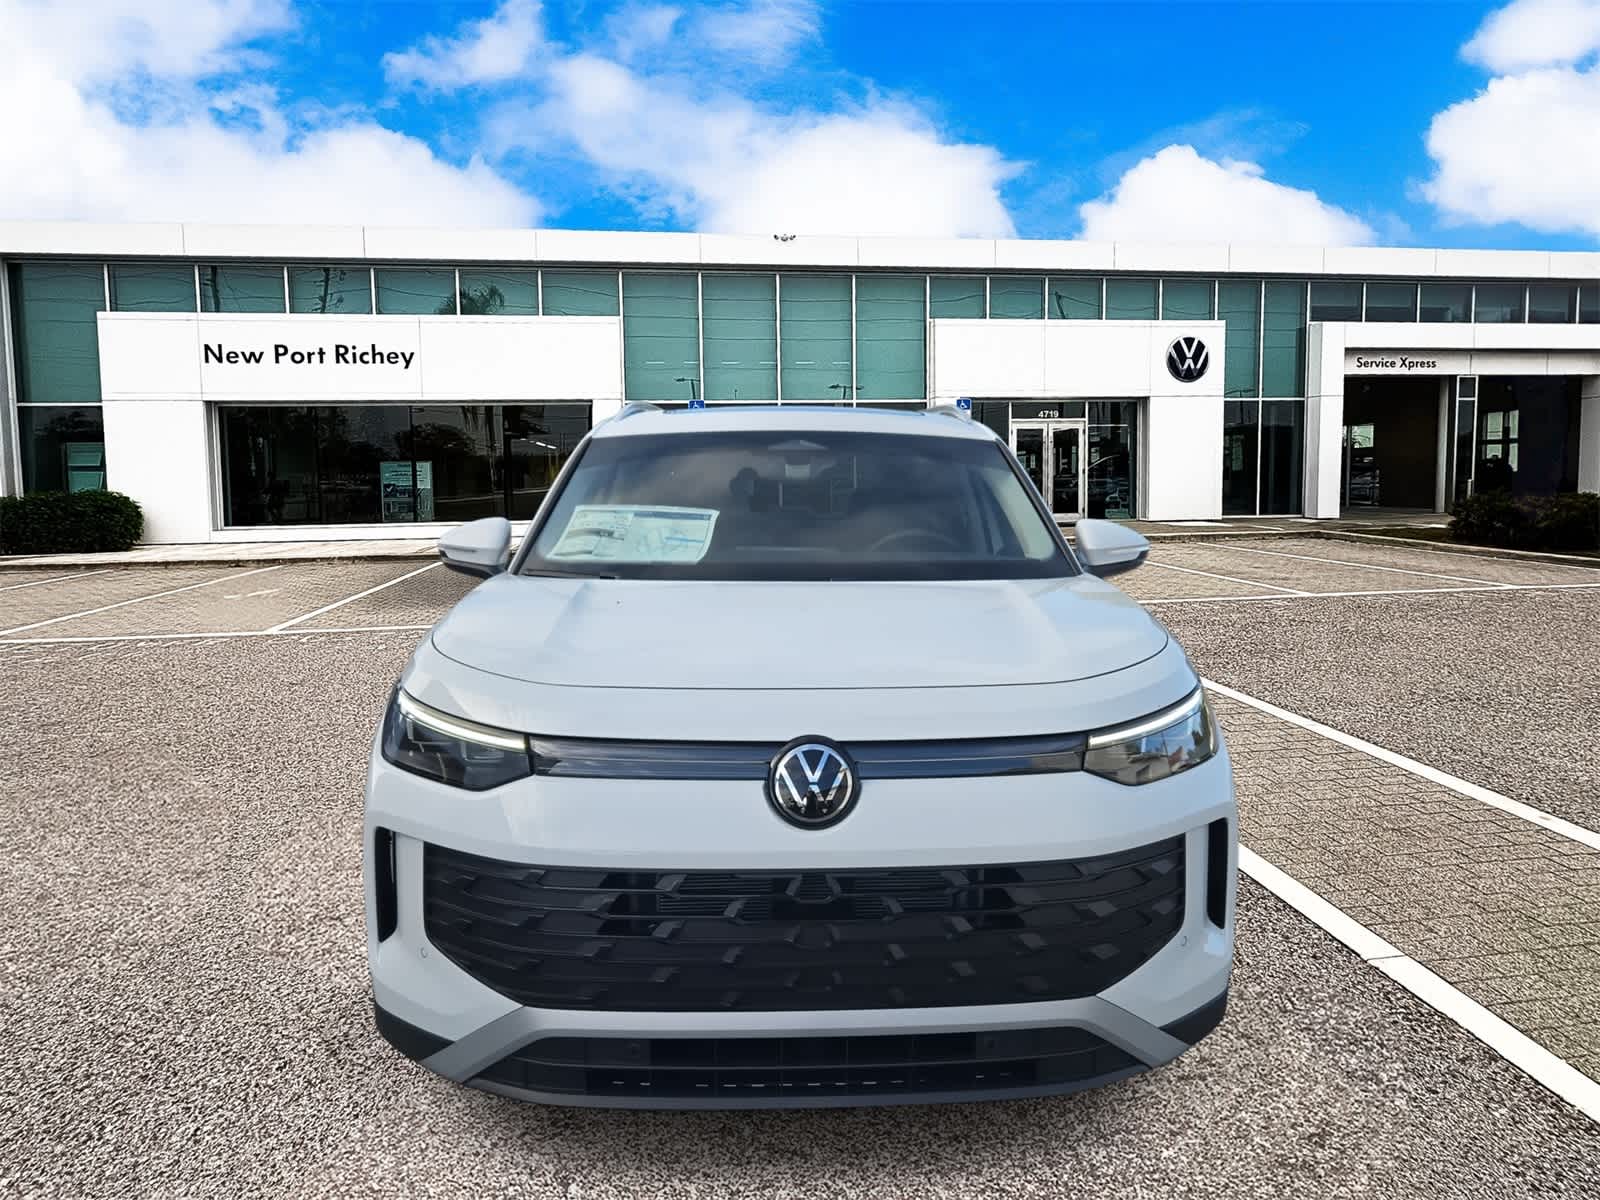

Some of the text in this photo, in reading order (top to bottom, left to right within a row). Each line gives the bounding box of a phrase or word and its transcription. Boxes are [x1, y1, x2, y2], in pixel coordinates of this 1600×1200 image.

[203, 343, 415, 370] New Port Richey
[1356, 356, 1437, 371] Service Xpress
[1038, 410, 1059, 418] 4719
